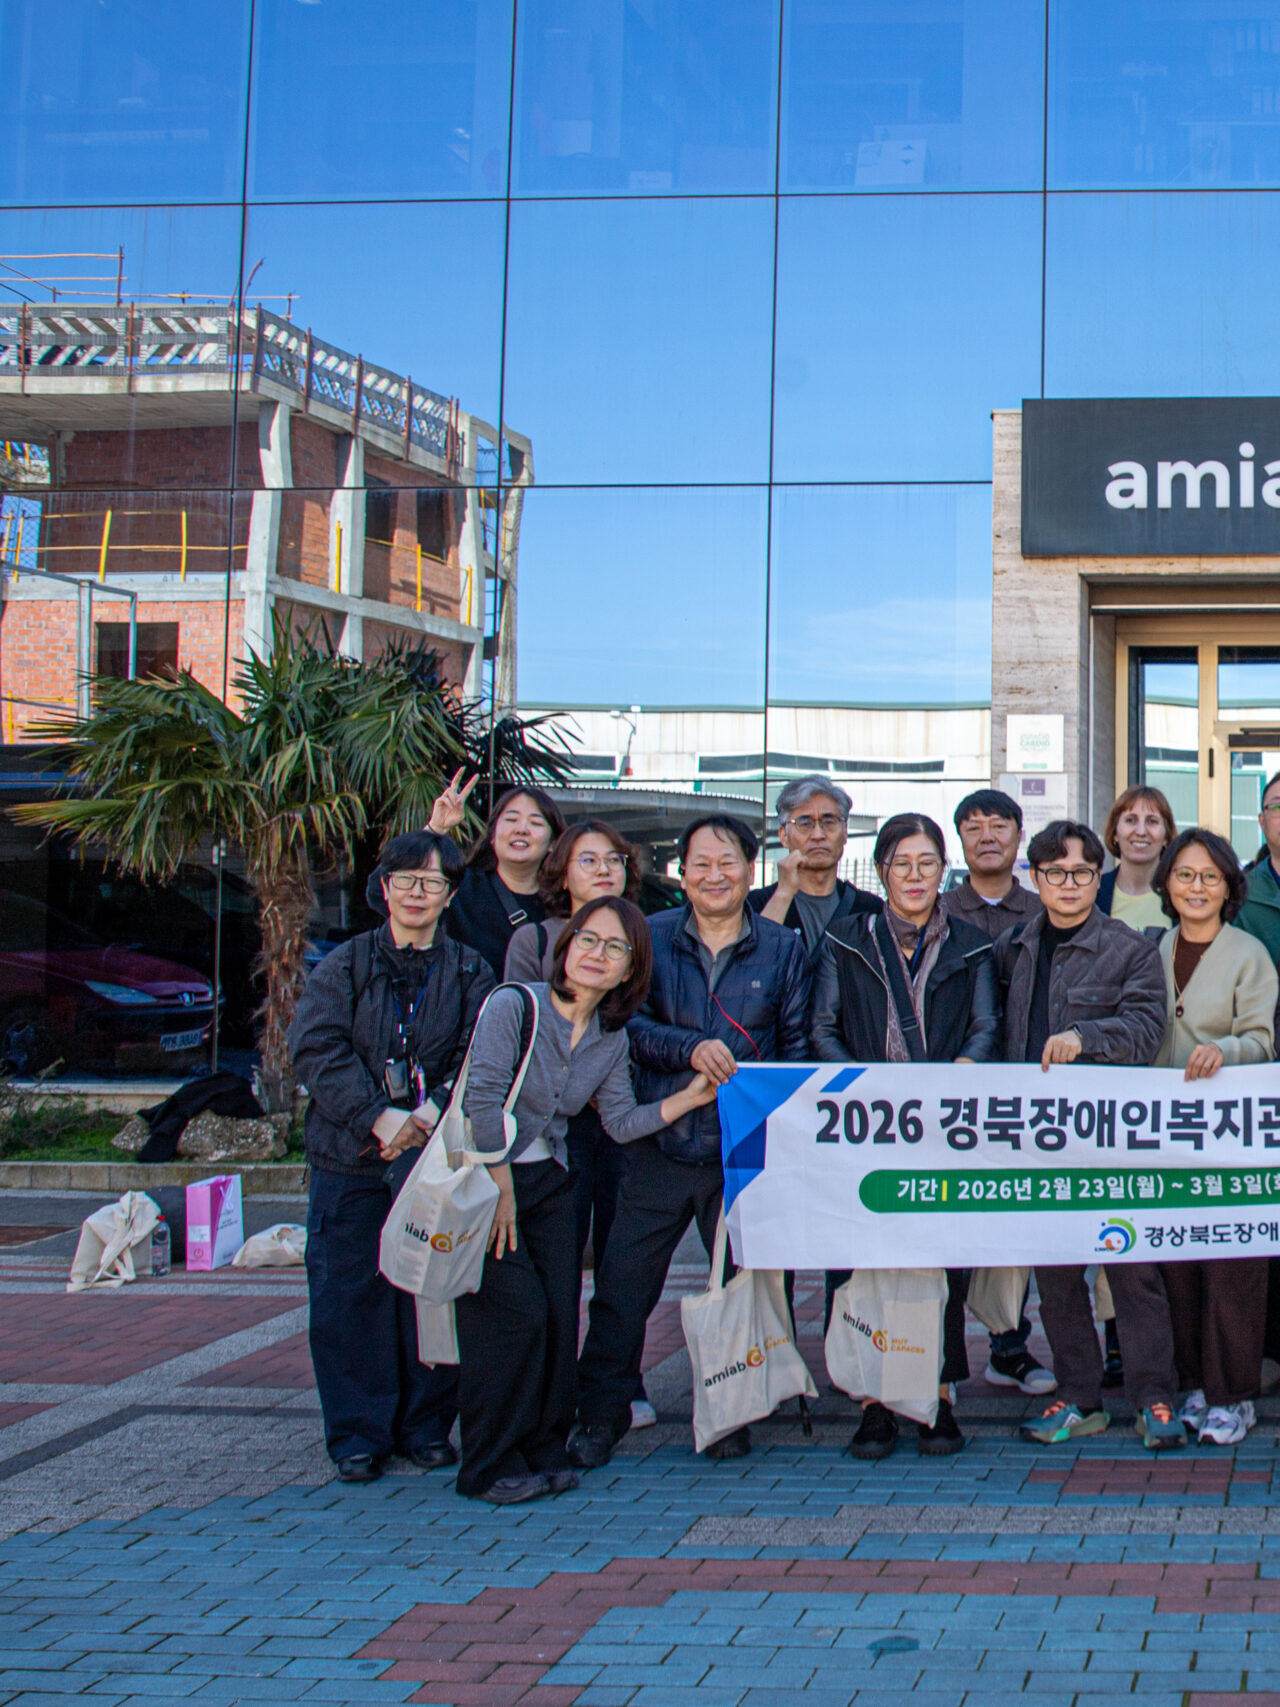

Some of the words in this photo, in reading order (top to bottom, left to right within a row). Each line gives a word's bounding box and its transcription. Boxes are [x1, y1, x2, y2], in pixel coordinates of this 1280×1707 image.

[816, 1099, 923, 1144] 2026
[898, 1178, 938, 1201] 기간
[958, 1178, 1031, 1200] 2026년
[1039, 1177, 1071, 1200] 2월
[1078, 1174, 1164, 1199] 23일(월)
[1190, 1174, 1223, 1196] 3월
[404, 1222, 429, 1242] iab
[843, 1312, 872, 1338] amiab
[704, 1361, 746, 1387] amiab
